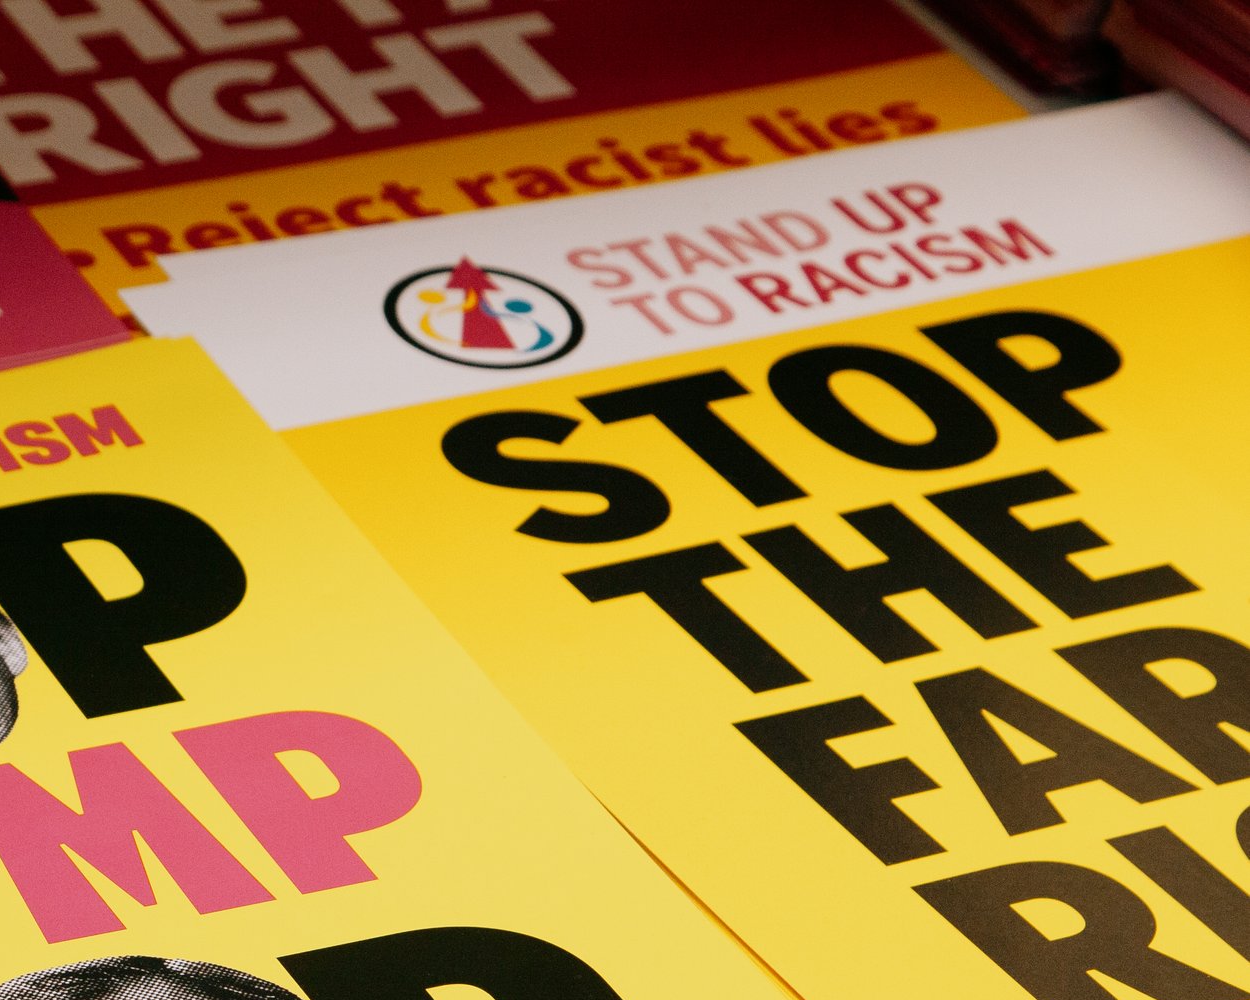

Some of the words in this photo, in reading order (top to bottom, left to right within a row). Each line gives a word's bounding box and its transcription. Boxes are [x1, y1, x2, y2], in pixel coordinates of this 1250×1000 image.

[101, 181, 442, 268] Reject
[455, 130, 748, 211] racist
[752, 98, 940, 159] lies
[566, 210, 832, 290] STAND
[831, 183, 946, 236] UP
[609, 286, 735, 338] TO
[735, 218, 1055, 315] RACISM
[441, 309, 1123, 544] STOP
[562, 468, 1203, 694] THE
[731, 626, 1250, 866] FAR
